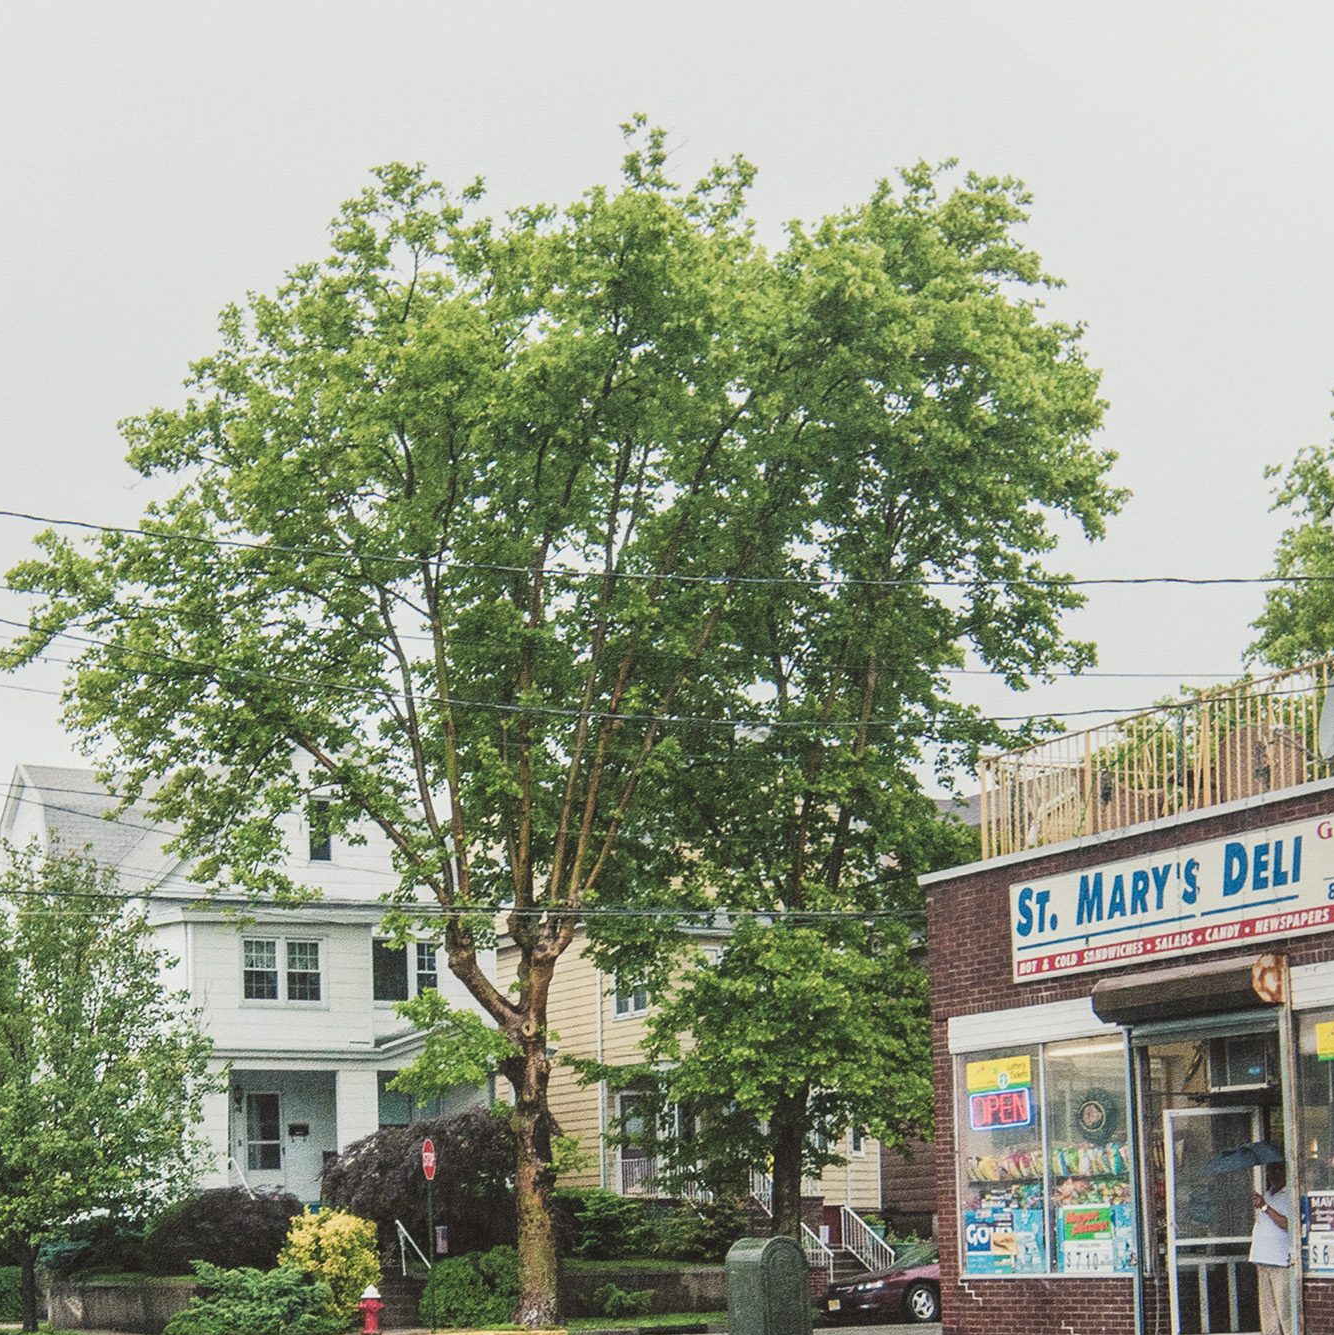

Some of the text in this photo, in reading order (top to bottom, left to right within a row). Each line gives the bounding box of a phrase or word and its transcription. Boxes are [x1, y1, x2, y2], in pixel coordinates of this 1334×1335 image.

[1016, 835, 1303, 937] ST. MARY'S DELI
[1019, 960, 1038, 975] HOT
[1042, 957, 1050, 971] &
[1054, 953, 1078, 969] COLD
[1083, 941, 1145, 964] SANDWICHES
[1155, 932, 1194, 951] SALADS
[1205, 923, 1241, 942] CANDY
[1255, 908, 1330, 934] NEWSPAPERS
[973, 1091, 1028, 1127] OPEN
